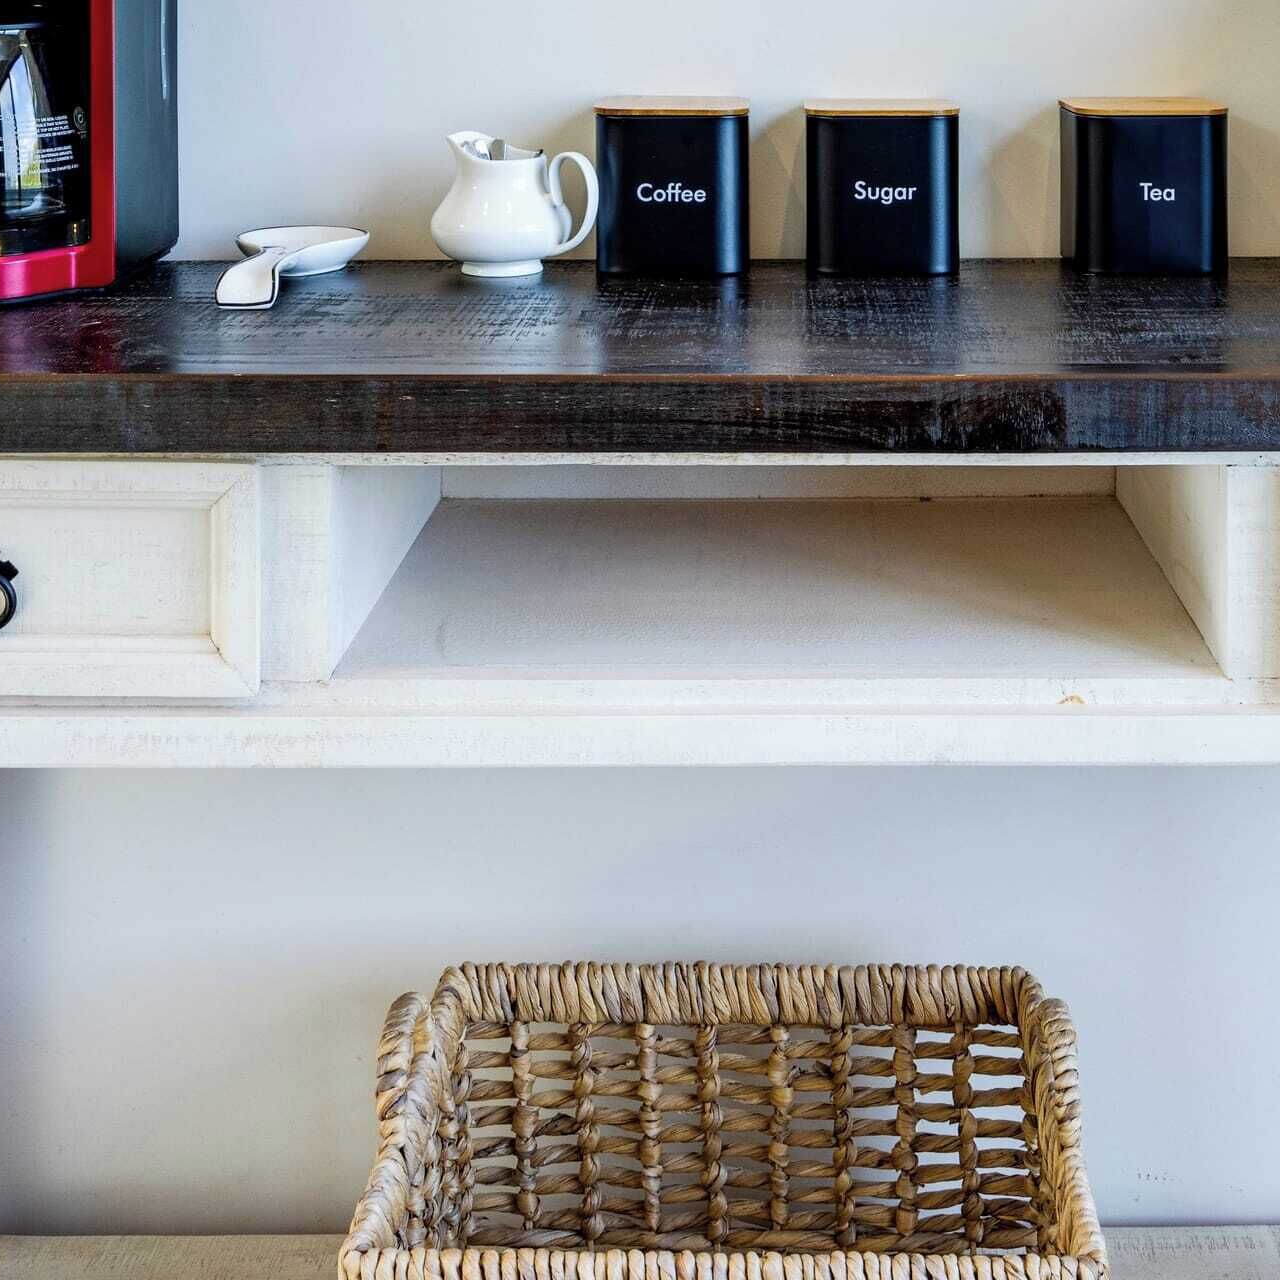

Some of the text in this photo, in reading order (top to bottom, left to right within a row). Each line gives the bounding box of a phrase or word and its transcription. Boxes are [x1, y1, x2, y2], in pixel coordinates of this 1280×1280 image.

[637, 182, 706, 202] Coffee
[854, 181, 917, 204] Sugar
[1139, 182, 1175, 201] Tea
